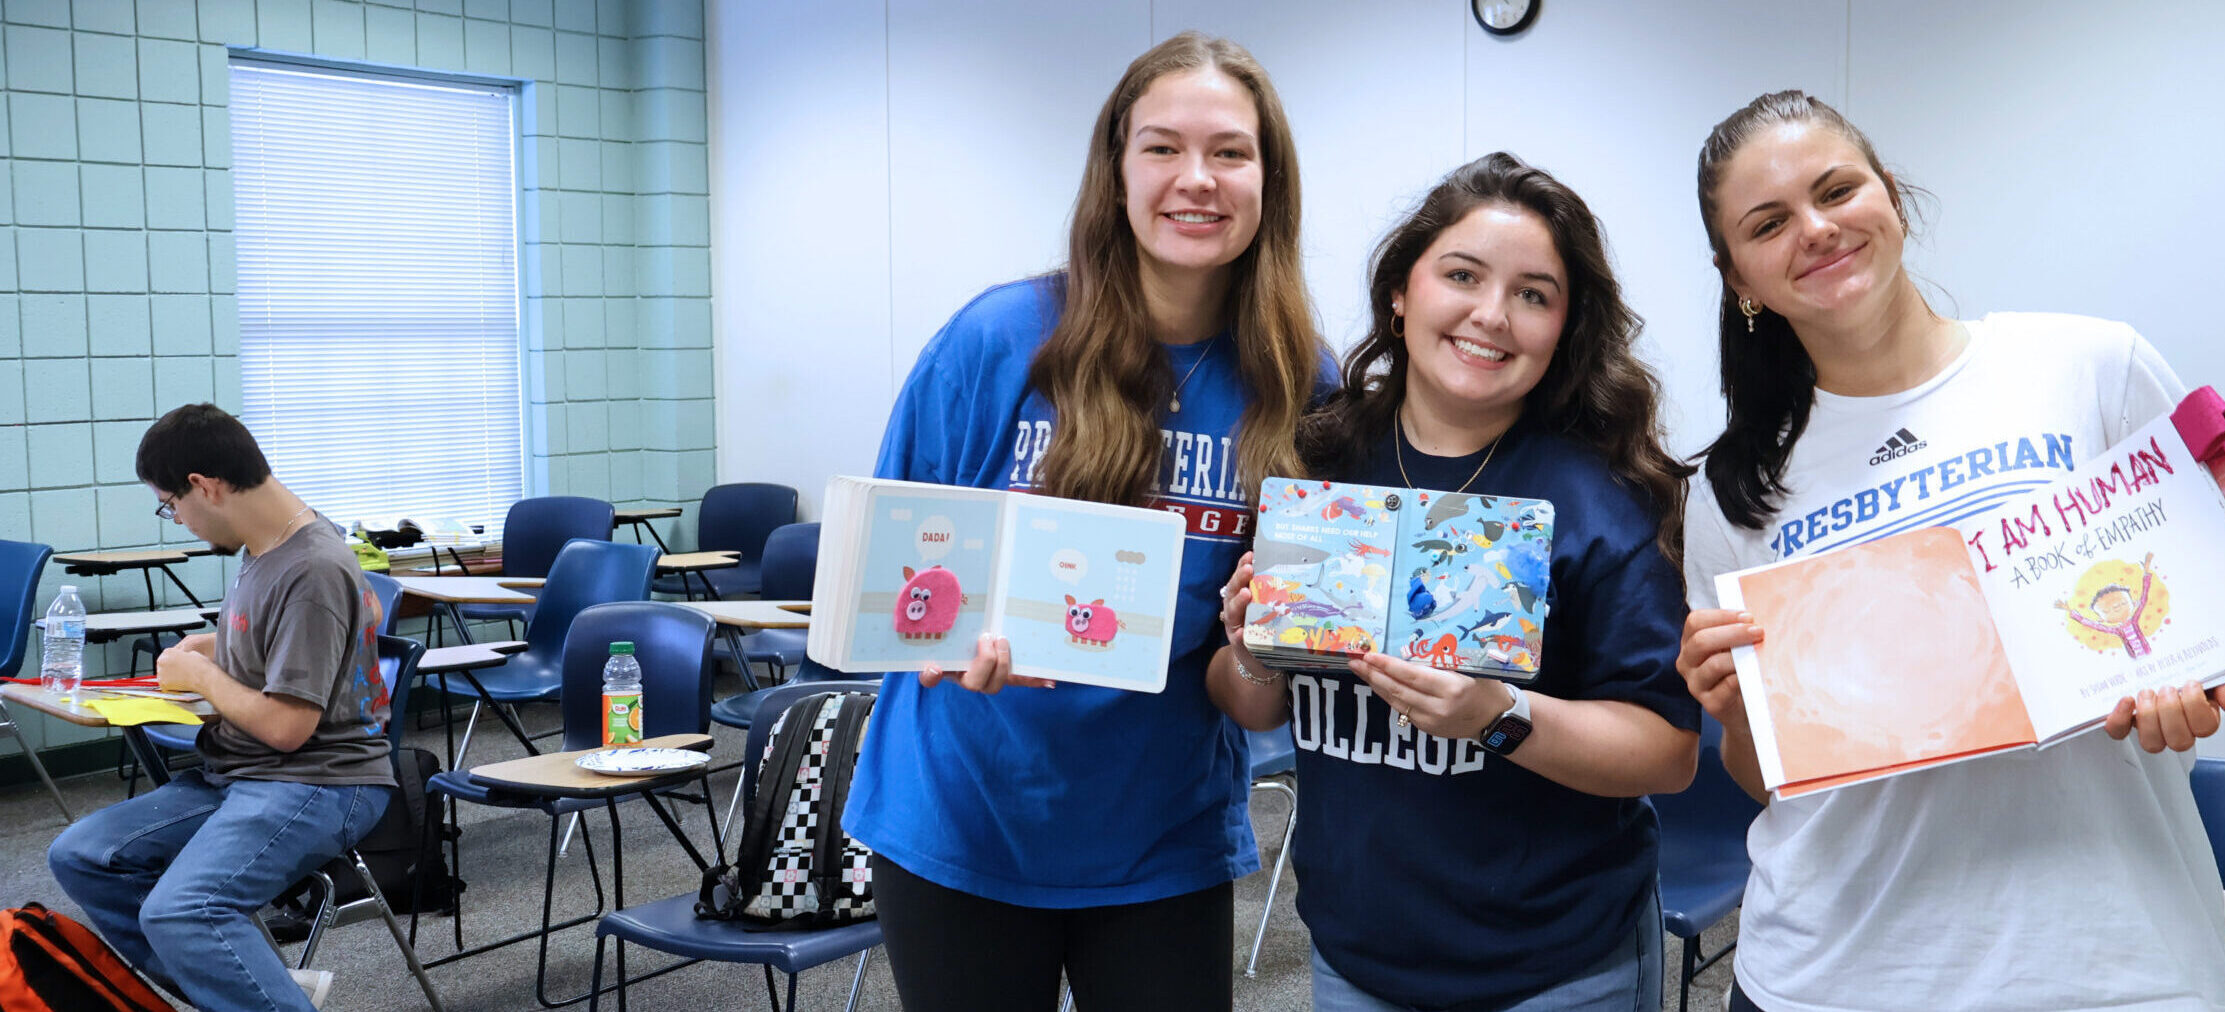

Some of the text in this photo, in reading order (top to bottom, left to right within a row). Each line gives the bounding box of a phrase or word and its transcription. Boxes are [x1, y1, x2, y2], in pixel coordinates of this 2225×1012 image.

[1869, 438, 1927, 466] adidas
[1321, 527, 1341, 535] NEED
[1968, 528, 1998, 572] I
[2001, 504, 2051, 555] AM
[2053, 435, 2174, 533] HUMAN
[922, 532, 950, 543] DADA!
[2010, 497, 2168, 589] A BOOK of EMPATHY
[1288, 674, 1485, 776] OLLEGE
